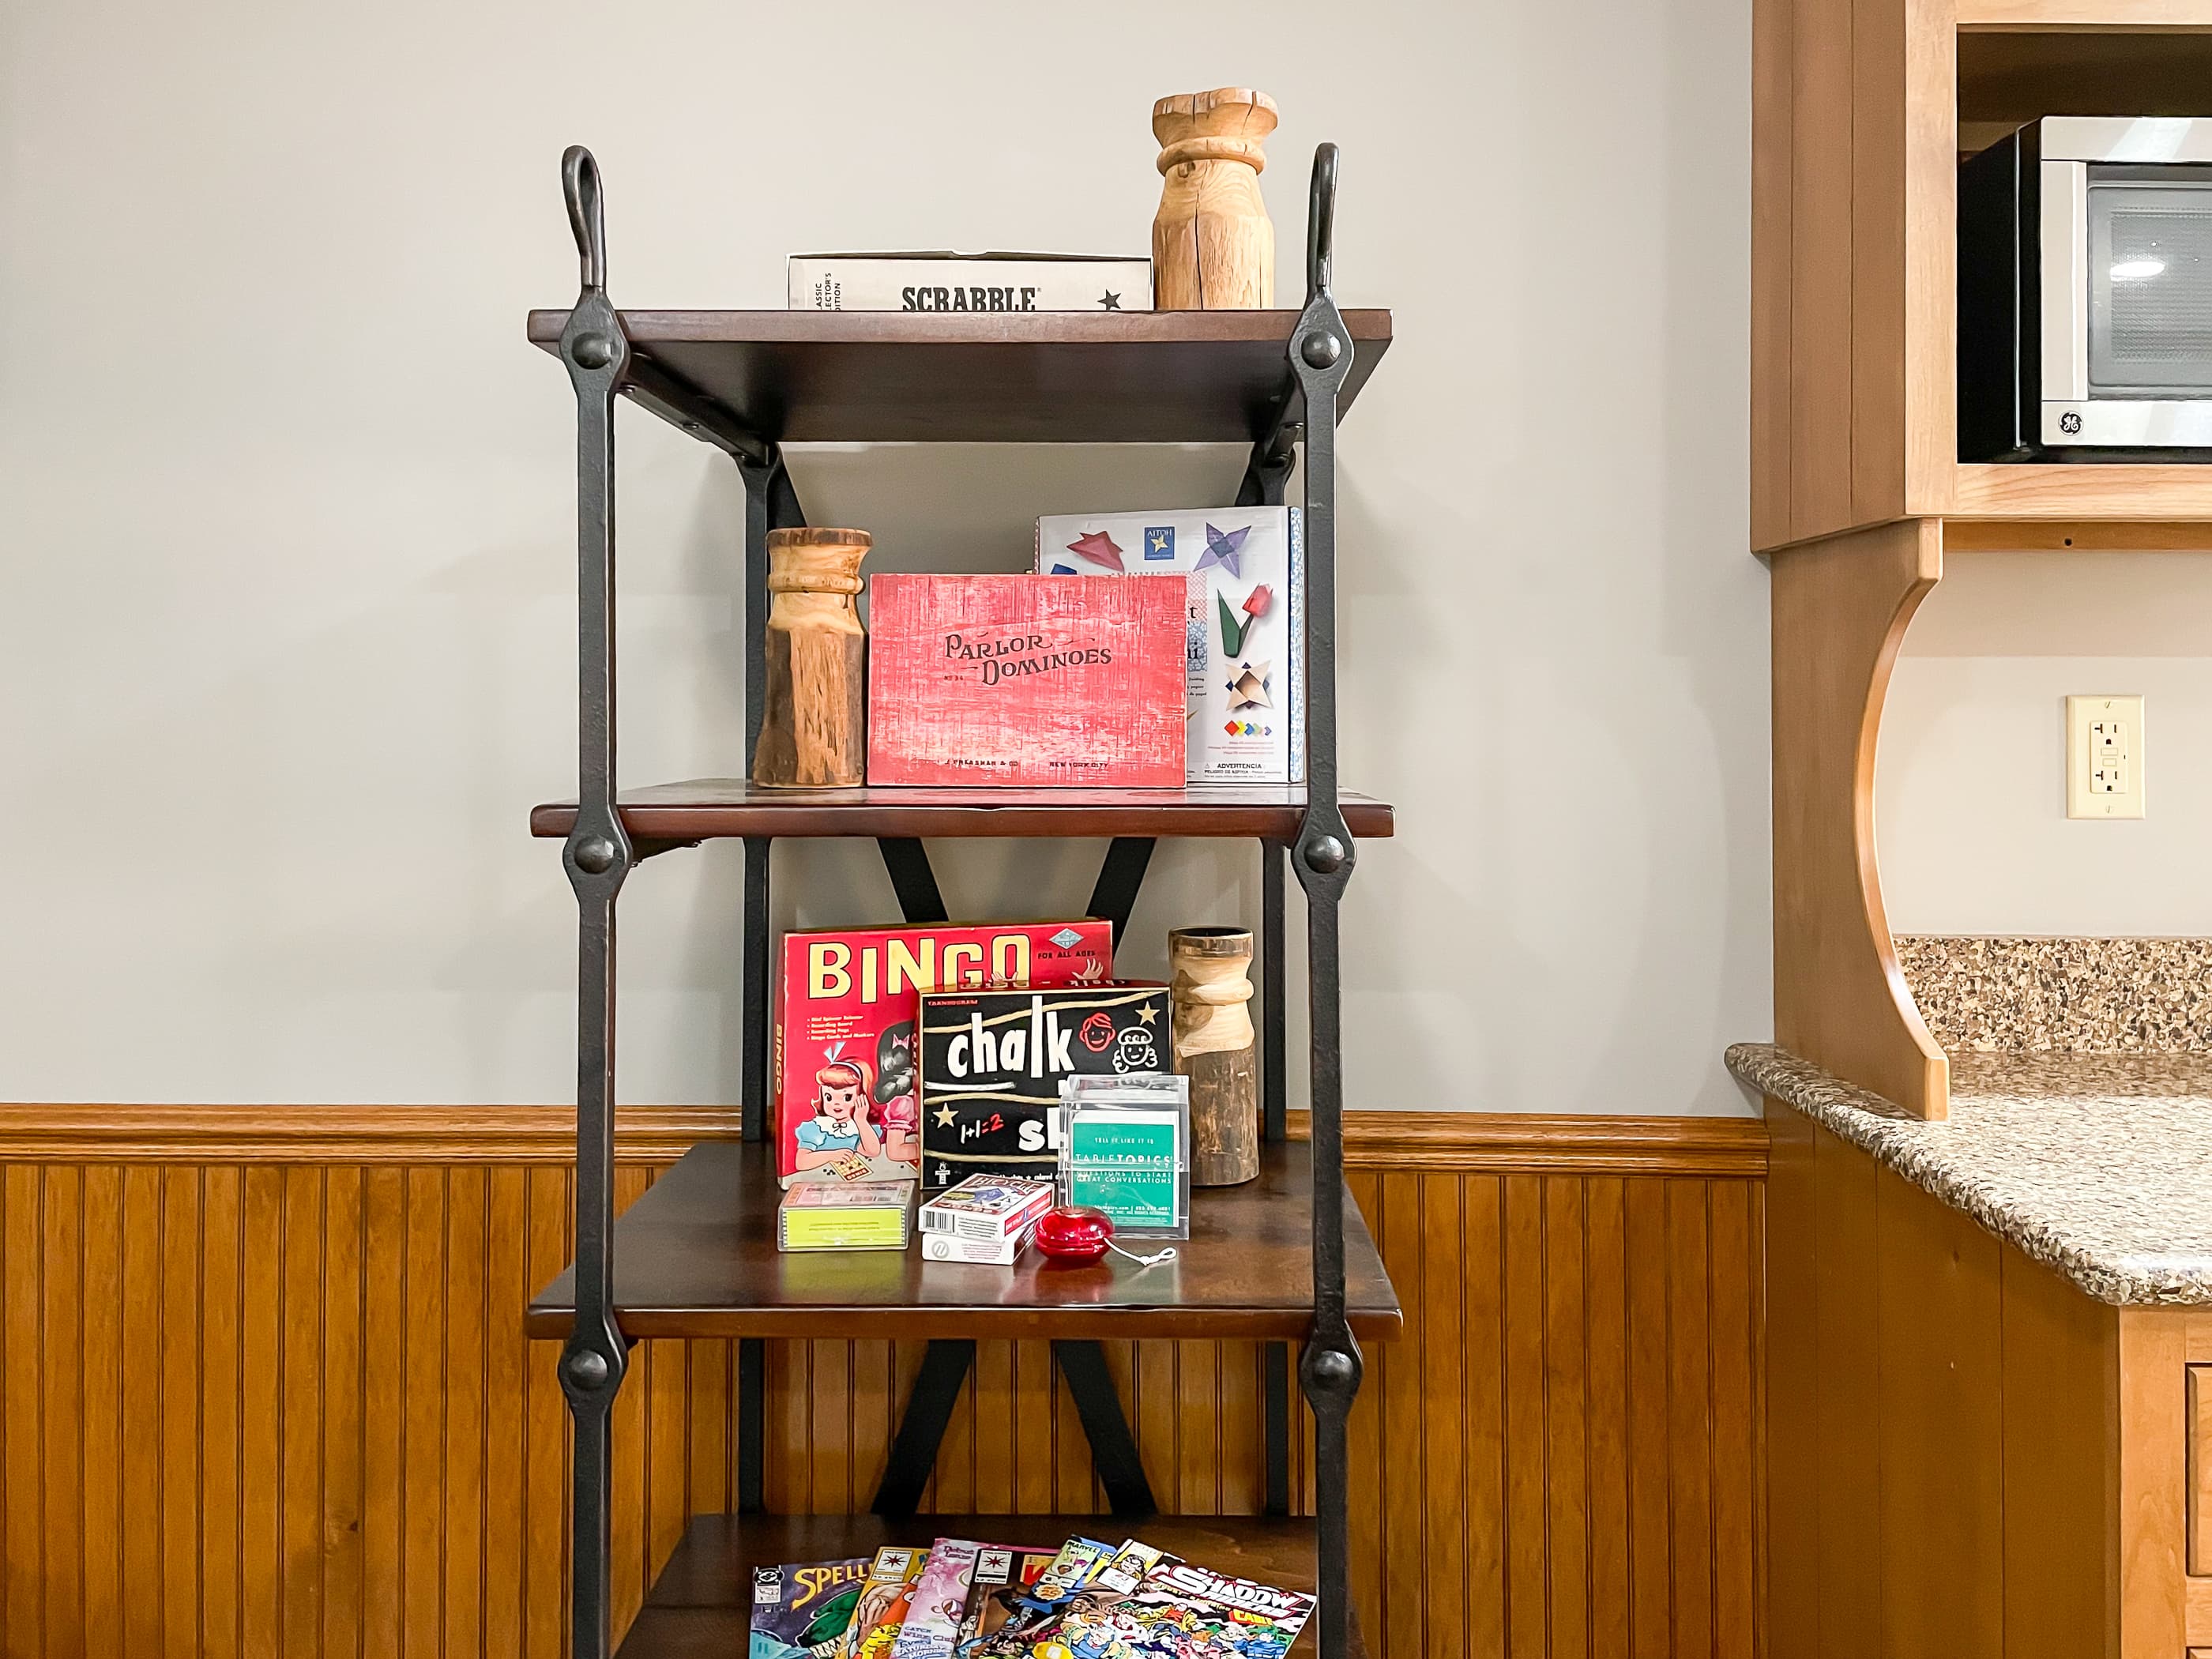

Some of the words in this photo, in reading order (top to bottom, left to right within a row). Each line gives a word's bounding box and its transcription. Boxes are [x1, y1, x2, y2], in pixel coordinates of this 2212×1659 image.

[902, 287, 1036, 311] SCRABBLE
[946, 634, 1053, 660] PARLOR
[981, 649, 1112, 686] DOMINOES
[808, 934, 1031, 1004] BINGO
[948, 995, 1075, 1078] chalk
[972, 1176, 1041, 1196] BICYCLE
[1067, 1541, 1098, 1553] MARVEL
[792, 1563, 873, 1612] SPELL
[1156, 1566, 1302, 1609] SHADOW
